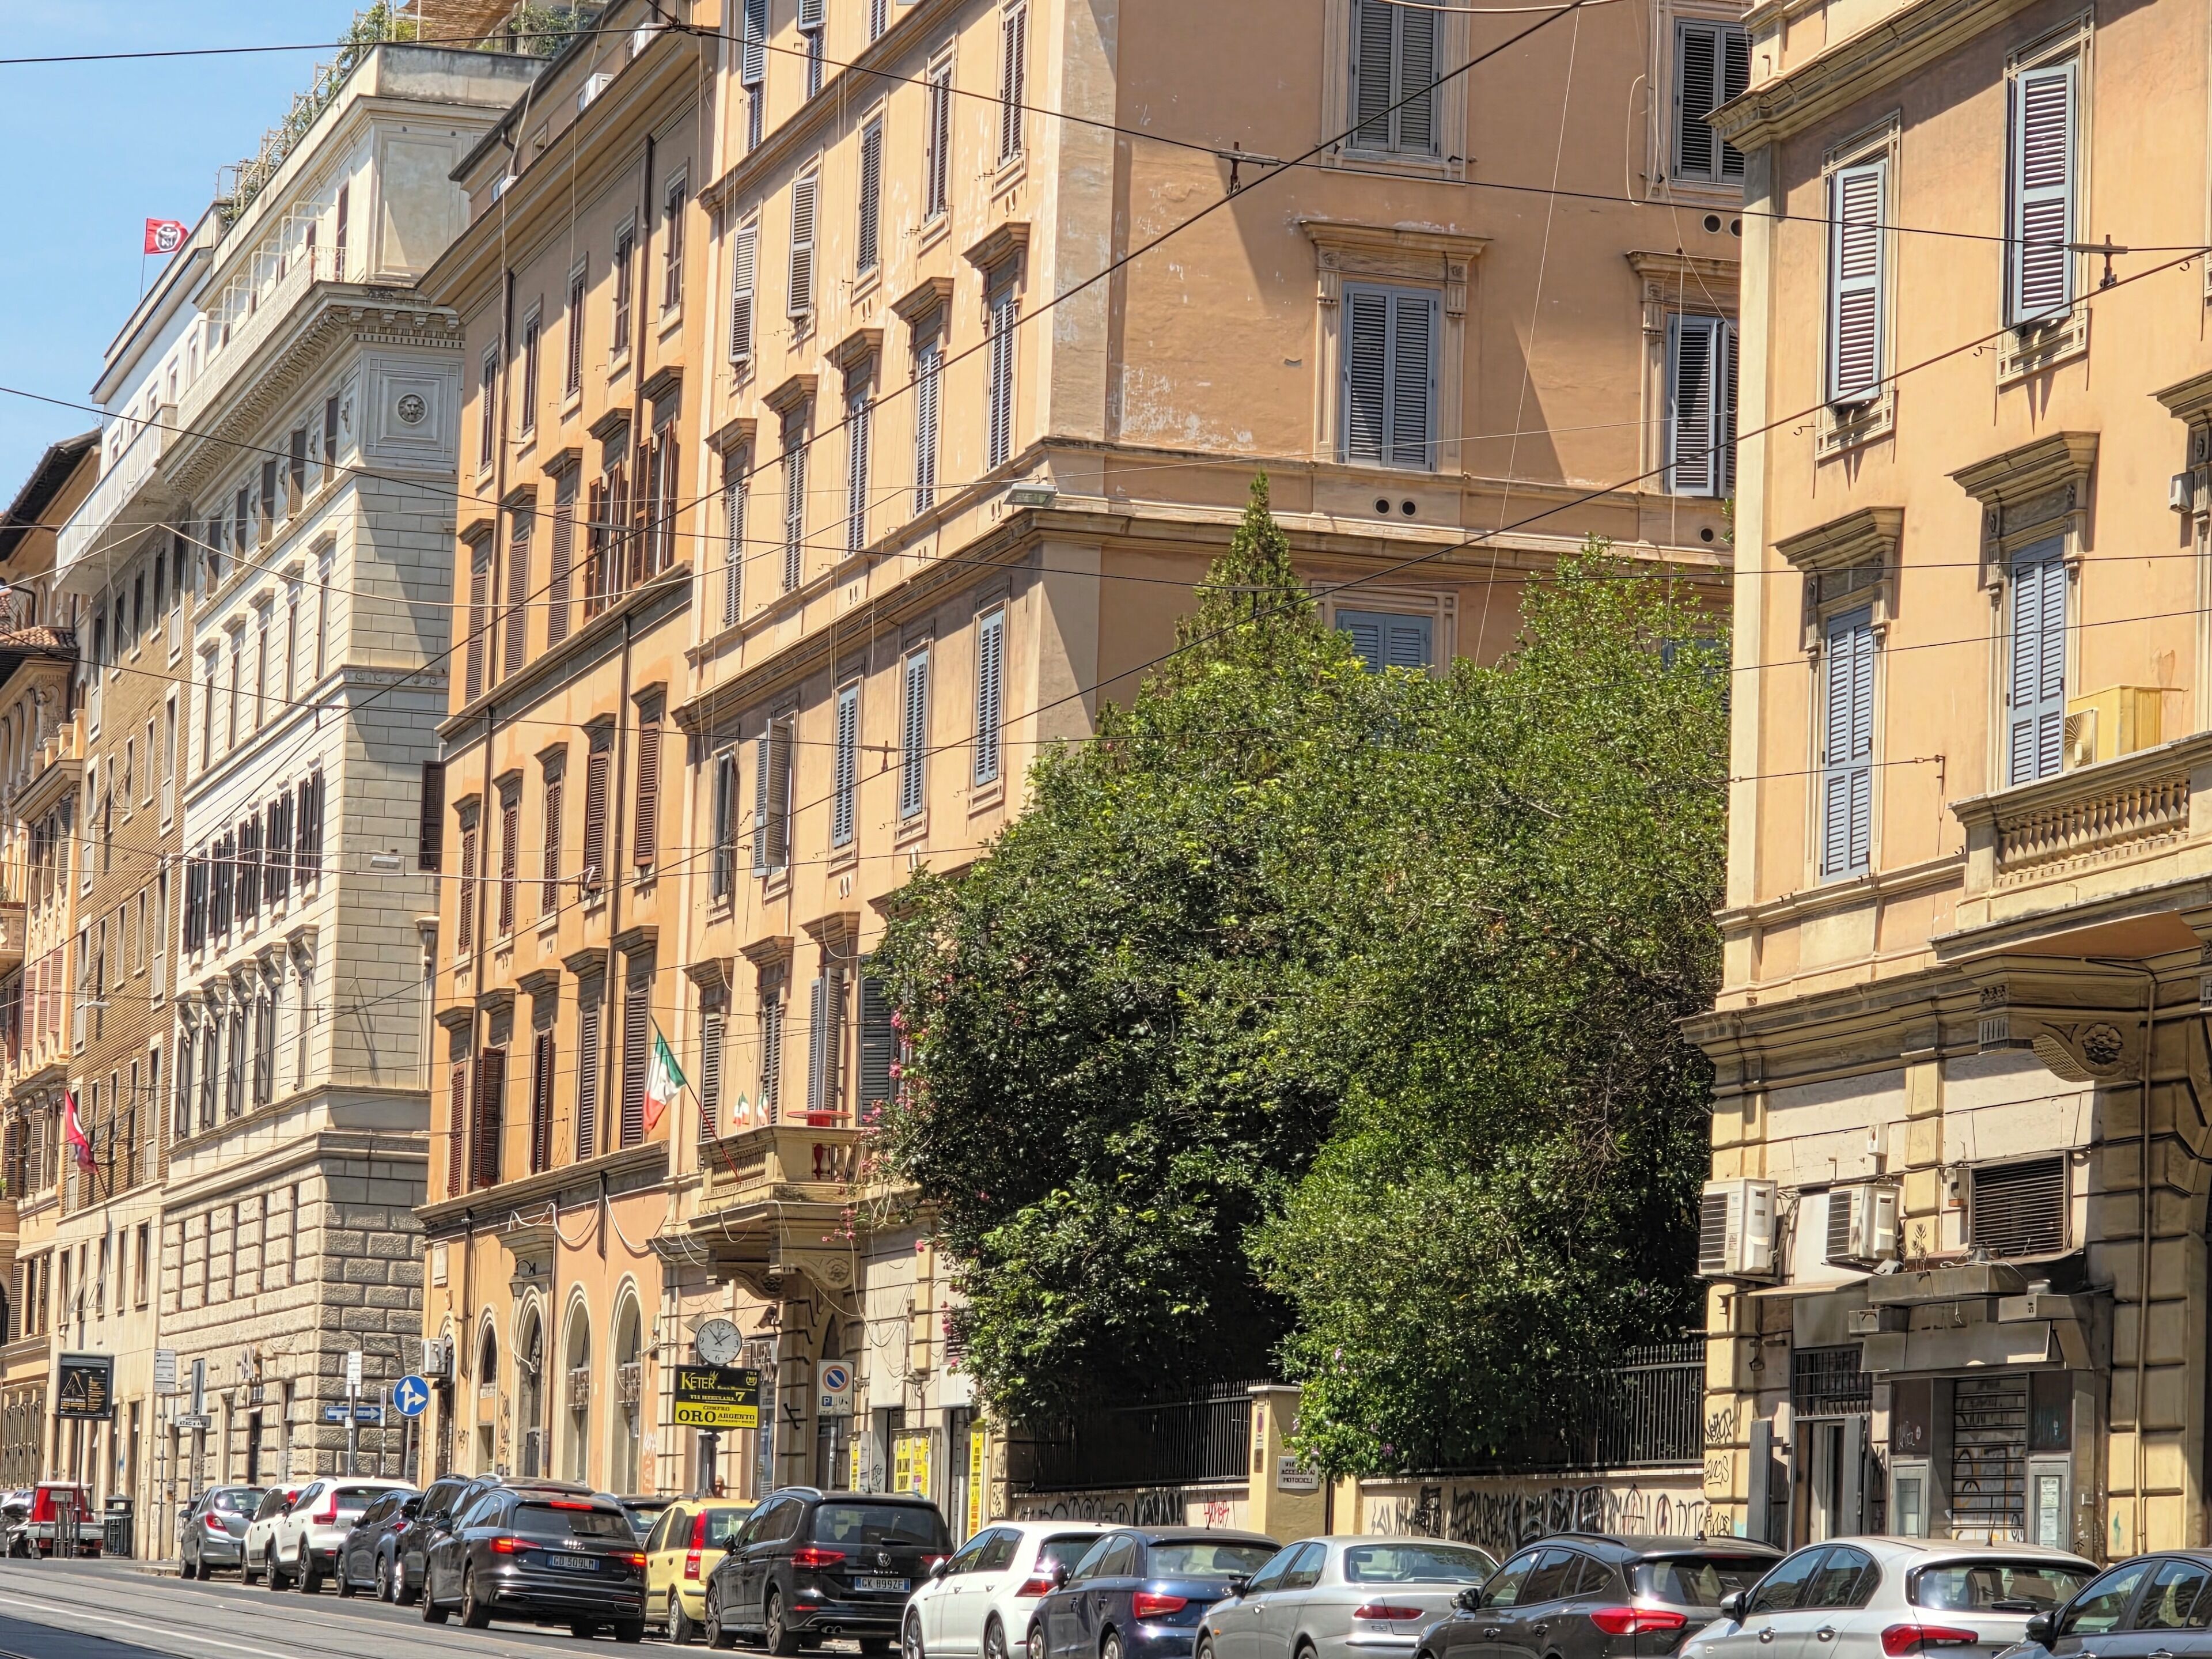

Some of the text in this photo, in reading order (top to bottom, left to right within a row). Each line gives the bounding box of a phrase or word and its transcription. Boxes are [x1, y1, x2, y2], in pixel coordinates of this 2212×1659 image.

[680, 1372, 715, 1390] KETER
[735, 1391, 745, 1402] 7
[678, 1410, 717, 1423] ORO
